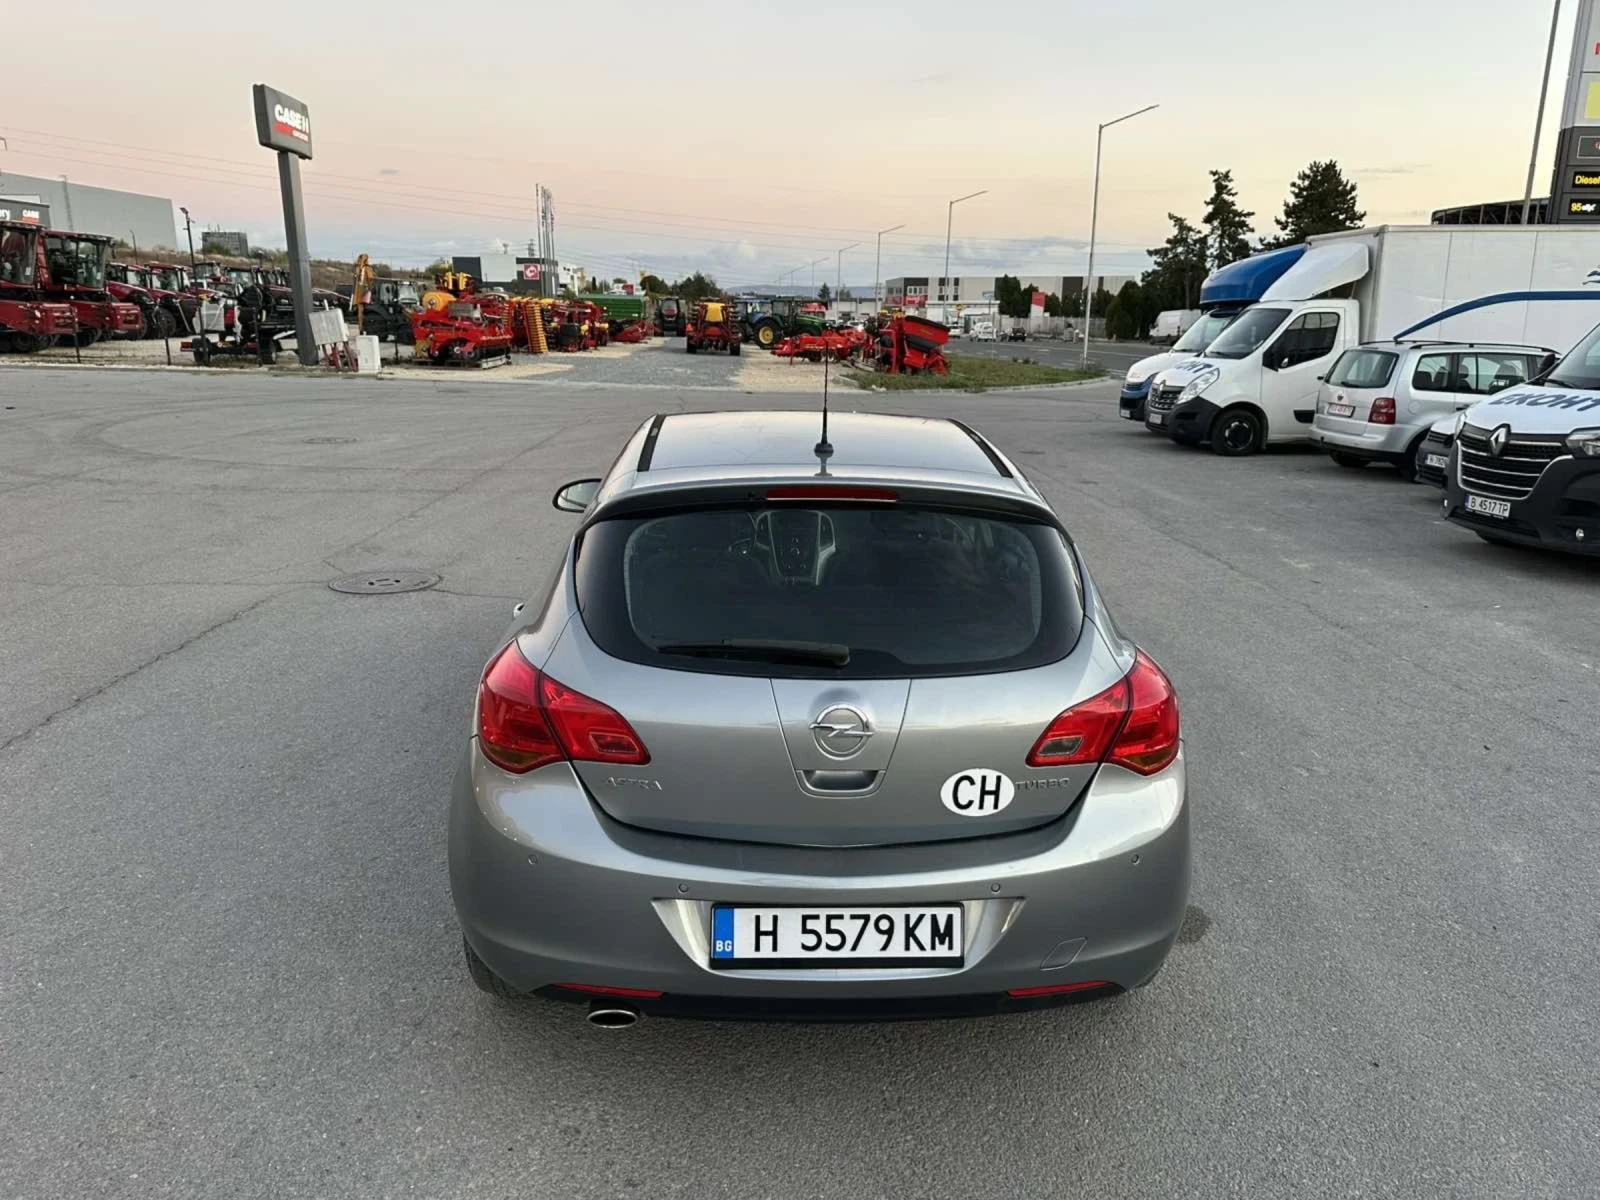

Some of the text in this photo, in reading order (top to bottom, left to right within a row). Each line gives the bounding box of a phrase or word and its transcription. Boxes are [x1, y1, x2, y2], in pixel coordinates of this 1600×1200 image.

[951, 774, 1003, 810] CH
[1014, 777, 1071, 792] TURBO
[715, 940, 733, 952] BG
[753, 914, 779, 953] H
